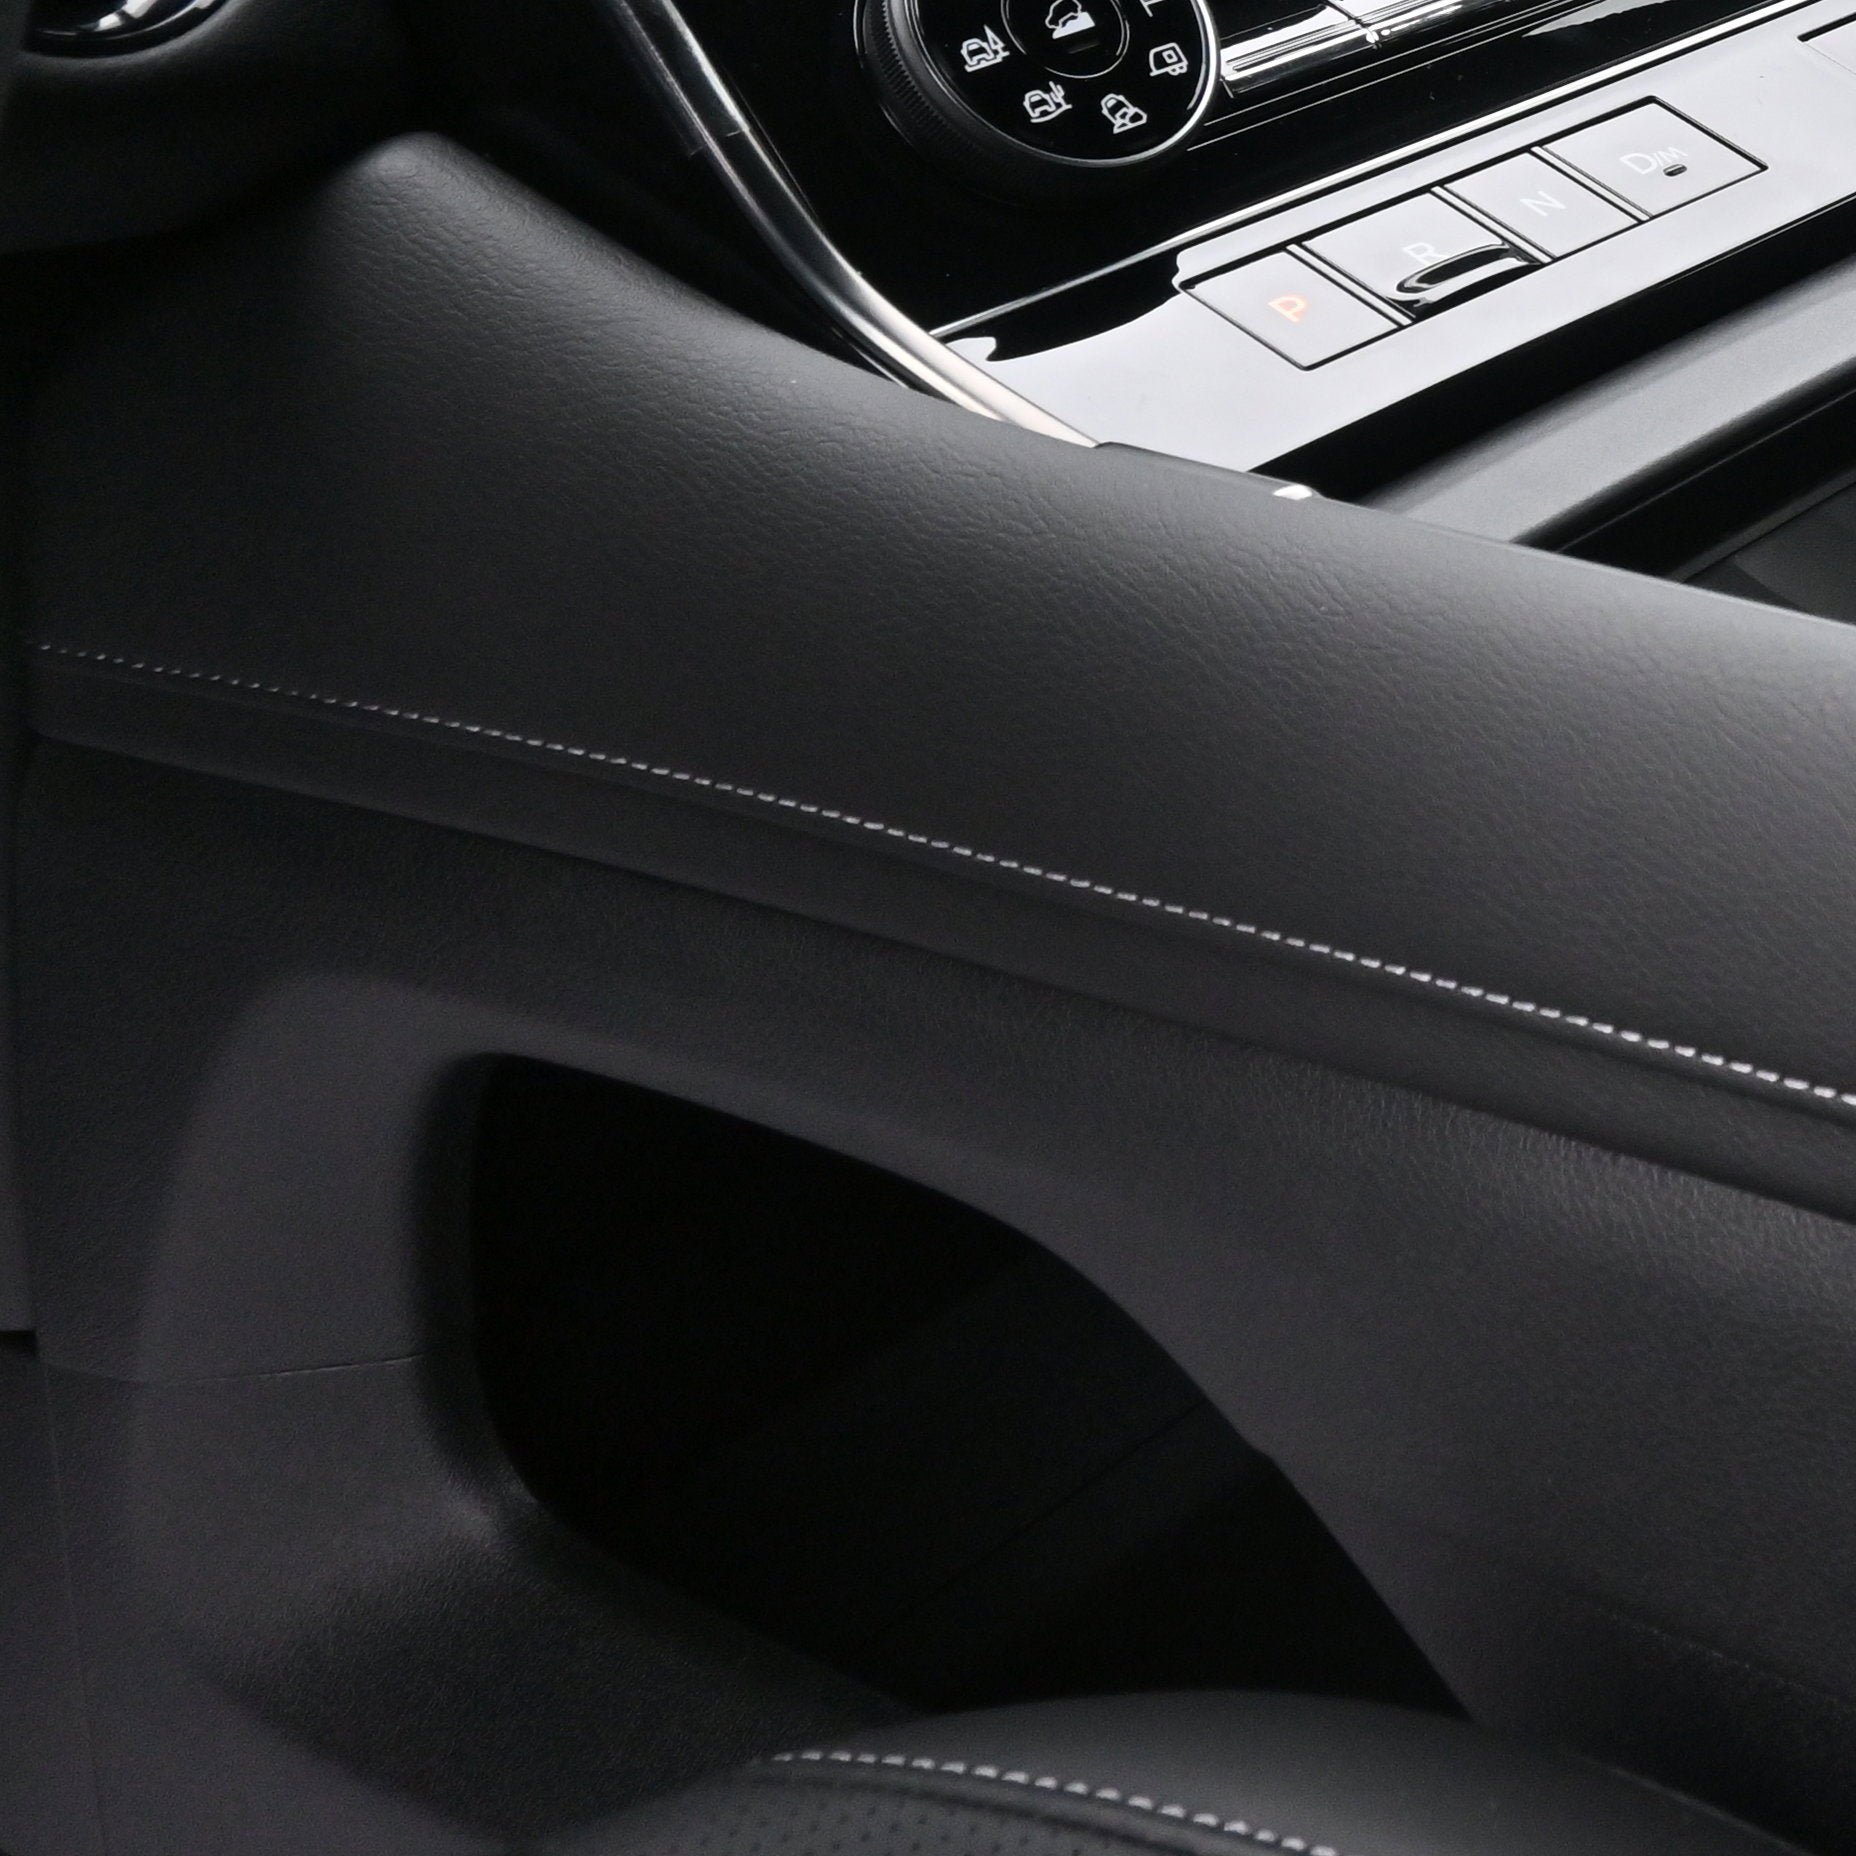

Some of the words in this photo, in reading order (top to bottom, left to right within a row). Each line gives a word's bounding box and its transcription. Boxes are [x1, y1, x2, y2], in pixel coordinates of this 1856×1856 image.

[1519, 189, 1568, 218] N
[1402, 240, 1446, 266] R
[1267, 294, 1310, 323] P
